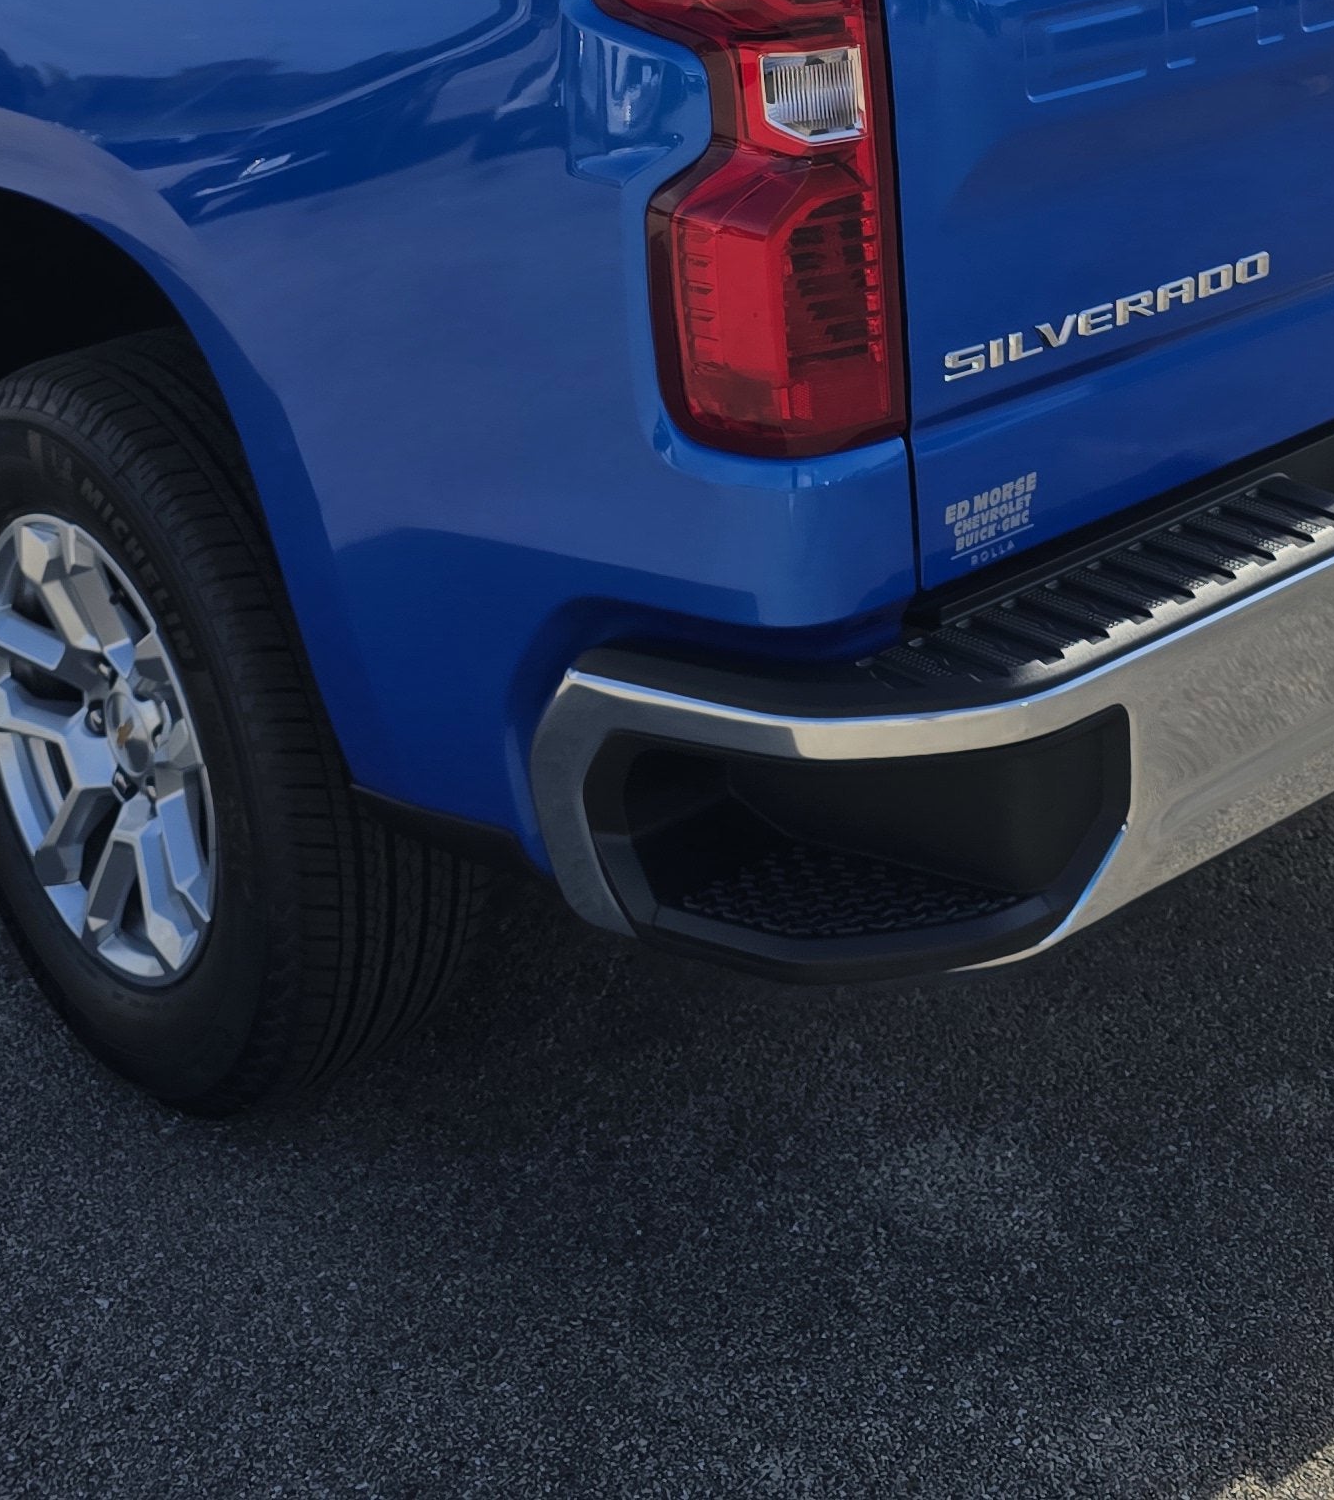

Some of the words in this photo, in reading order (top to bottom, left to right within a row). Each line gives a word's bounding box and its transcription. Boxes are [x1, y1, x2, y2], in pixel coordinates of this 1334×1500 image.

[943, 250, 1271, 382] SILVERADO
[945, 499, 970, 525] ED
[973, 471, 1037, 514] MORSE
[954, 493, 1032, 537] CHEVROLET
[79, 476, 198, 660] MICHELIN
[970, 539, 1015, 566] ROLLA
